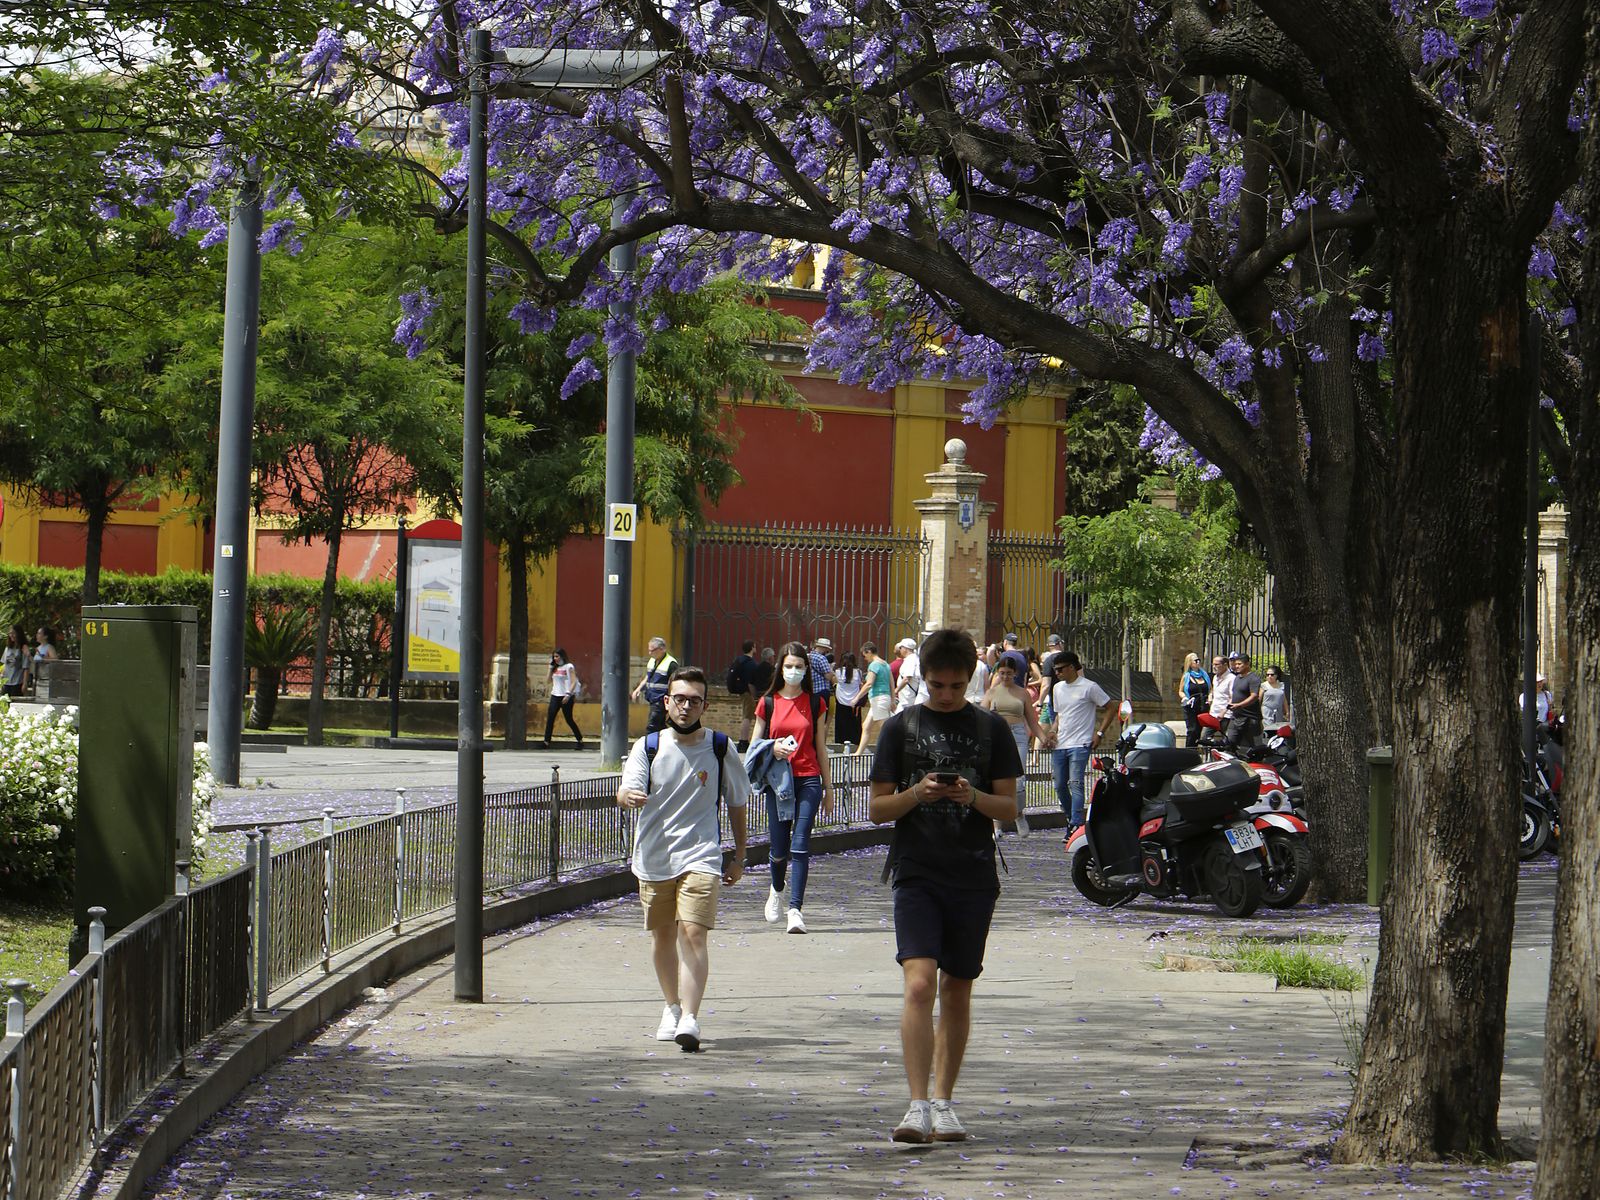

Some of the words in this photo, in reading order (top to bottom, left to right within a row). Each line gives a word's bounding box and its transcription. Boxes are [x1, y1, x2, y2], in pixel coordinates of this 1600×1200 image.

[613, 512, 632, 532] 20
[85, 621, 109, 637] 61
[1233, 826, 1255, 839] 3834
[1237, 837, 1255, 850] LHT
